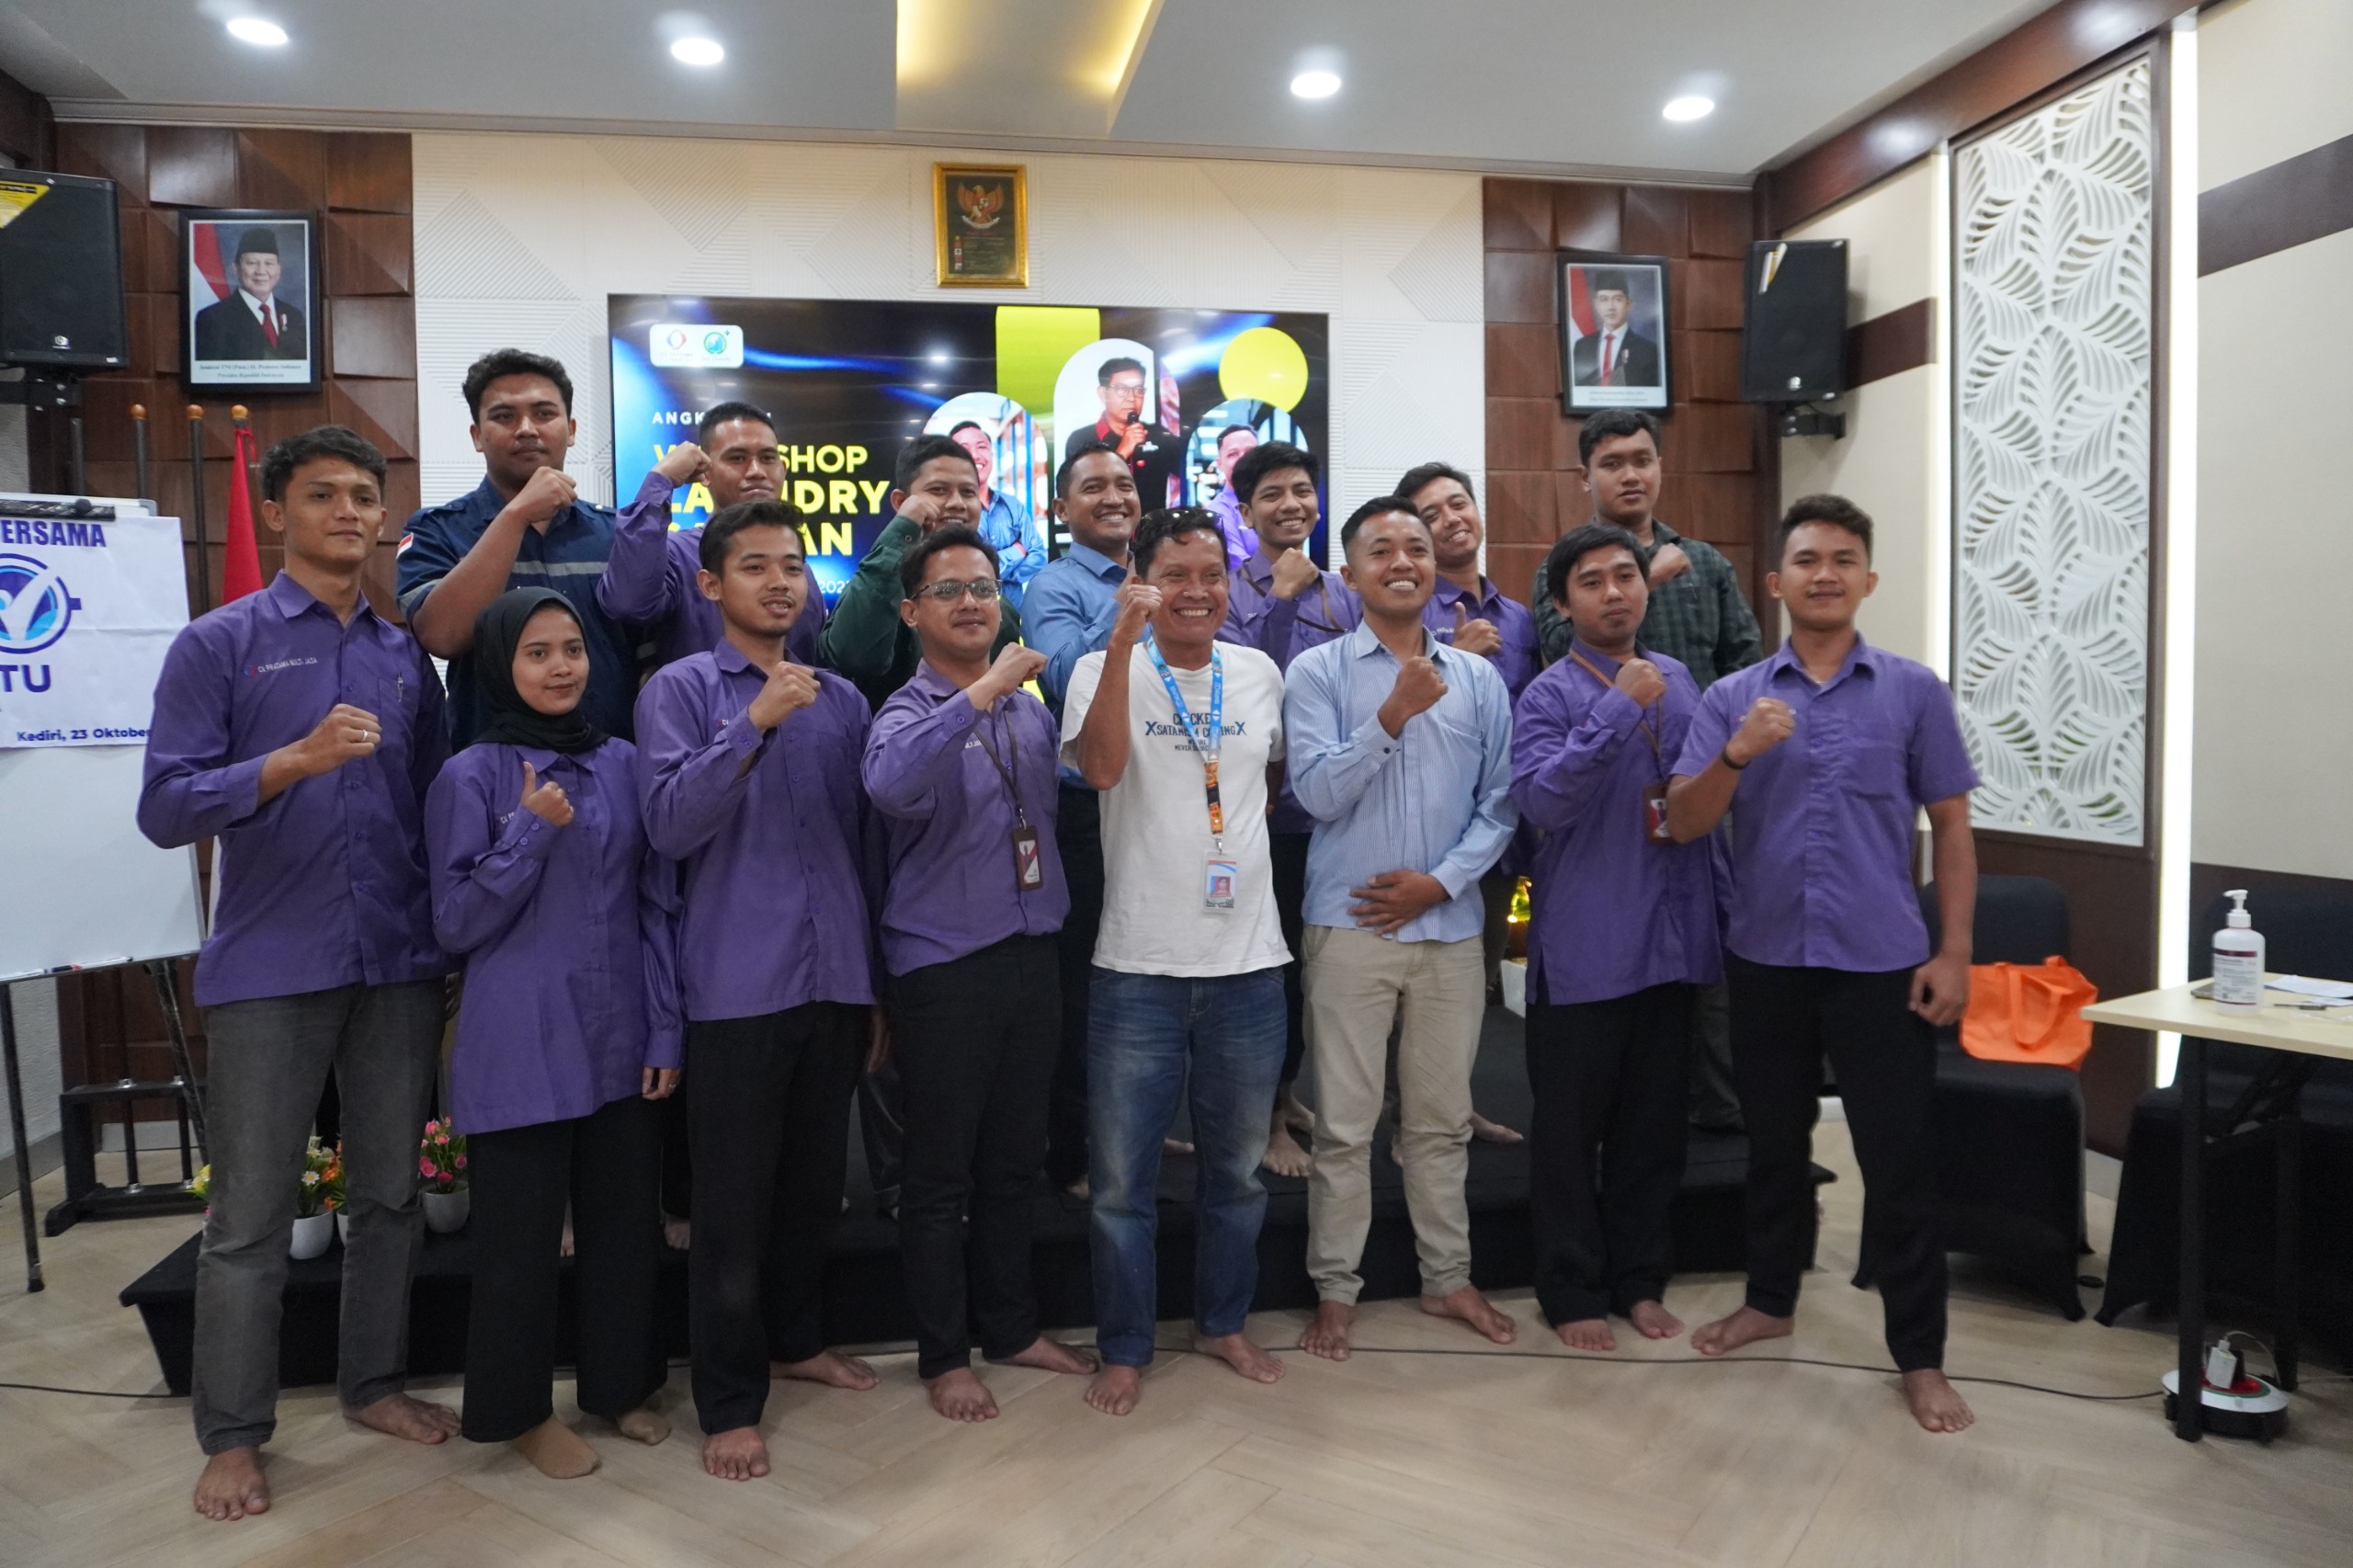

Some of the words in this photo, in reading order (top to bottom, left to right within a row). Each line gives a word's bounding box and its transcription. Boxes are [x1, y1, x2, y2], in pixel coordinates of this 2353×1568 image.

[818, 580, 850, 594] 202
[0, 665, 51, 693] TU
[17, 730, 66, 742] Kediri,
[70, 729, 88, 740] 23
